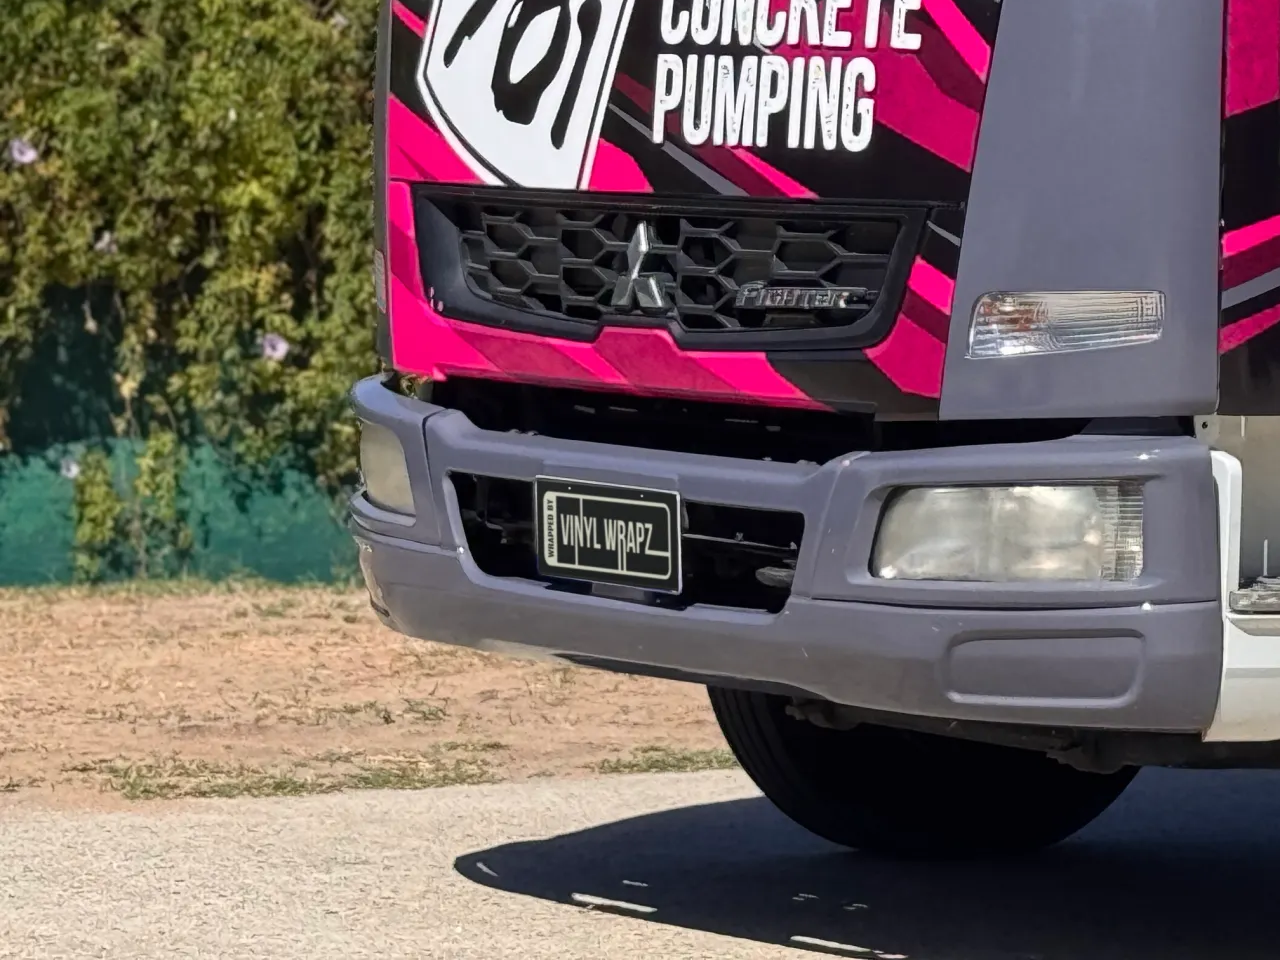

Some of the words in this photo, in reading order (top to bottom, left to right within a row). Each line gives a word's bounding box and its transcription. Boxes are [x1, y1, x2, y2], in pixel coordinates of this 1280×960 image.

[651, 53, 876, 152] PUMPING
[546, 498, 555, 511] BY
[547, 513, 555, 558] WRAPPED
[560, 508, 602, 554] VINYL
[603, 518, 655, 561] WRAPZ
